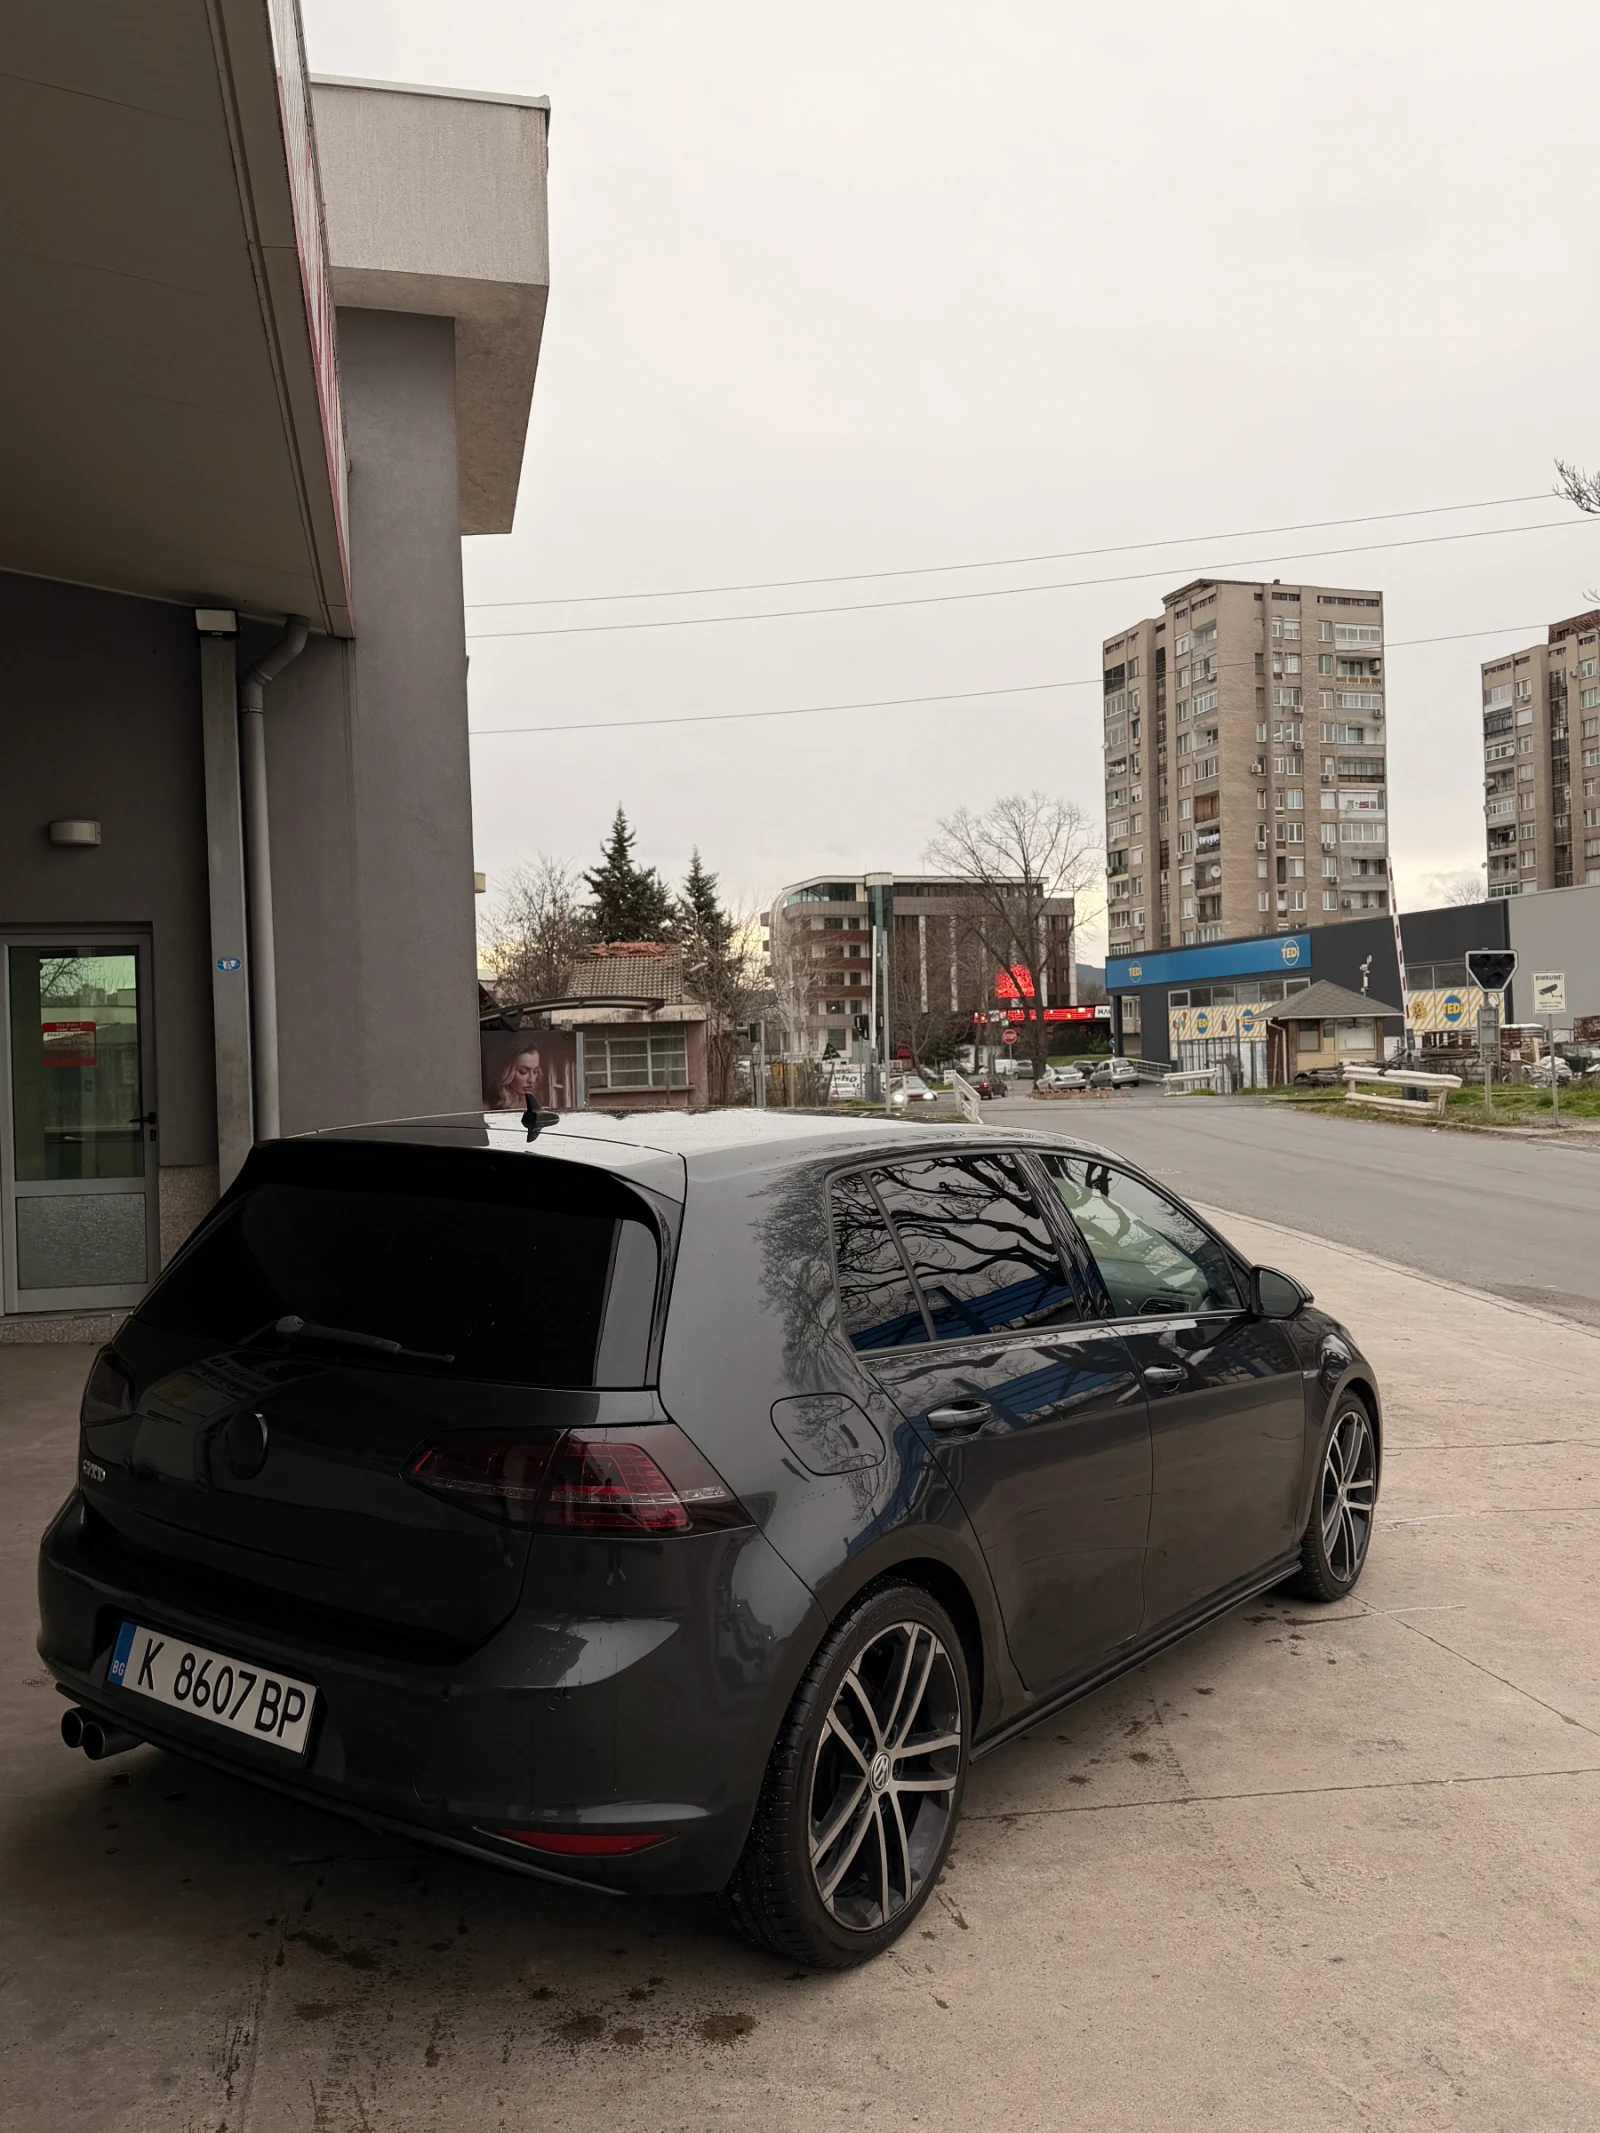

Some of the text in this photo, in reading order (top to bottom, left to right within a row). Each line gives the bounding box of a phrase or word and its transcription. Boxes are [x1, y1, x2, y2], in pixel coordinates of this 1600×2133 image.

[1281, 947, 1299, 959] TEDi
[1441, 1002, 1464, 1015] TEDi
[112, 1660, 125, 1676] BG
[137, 1638, 306, 1738] K 8607 BP
